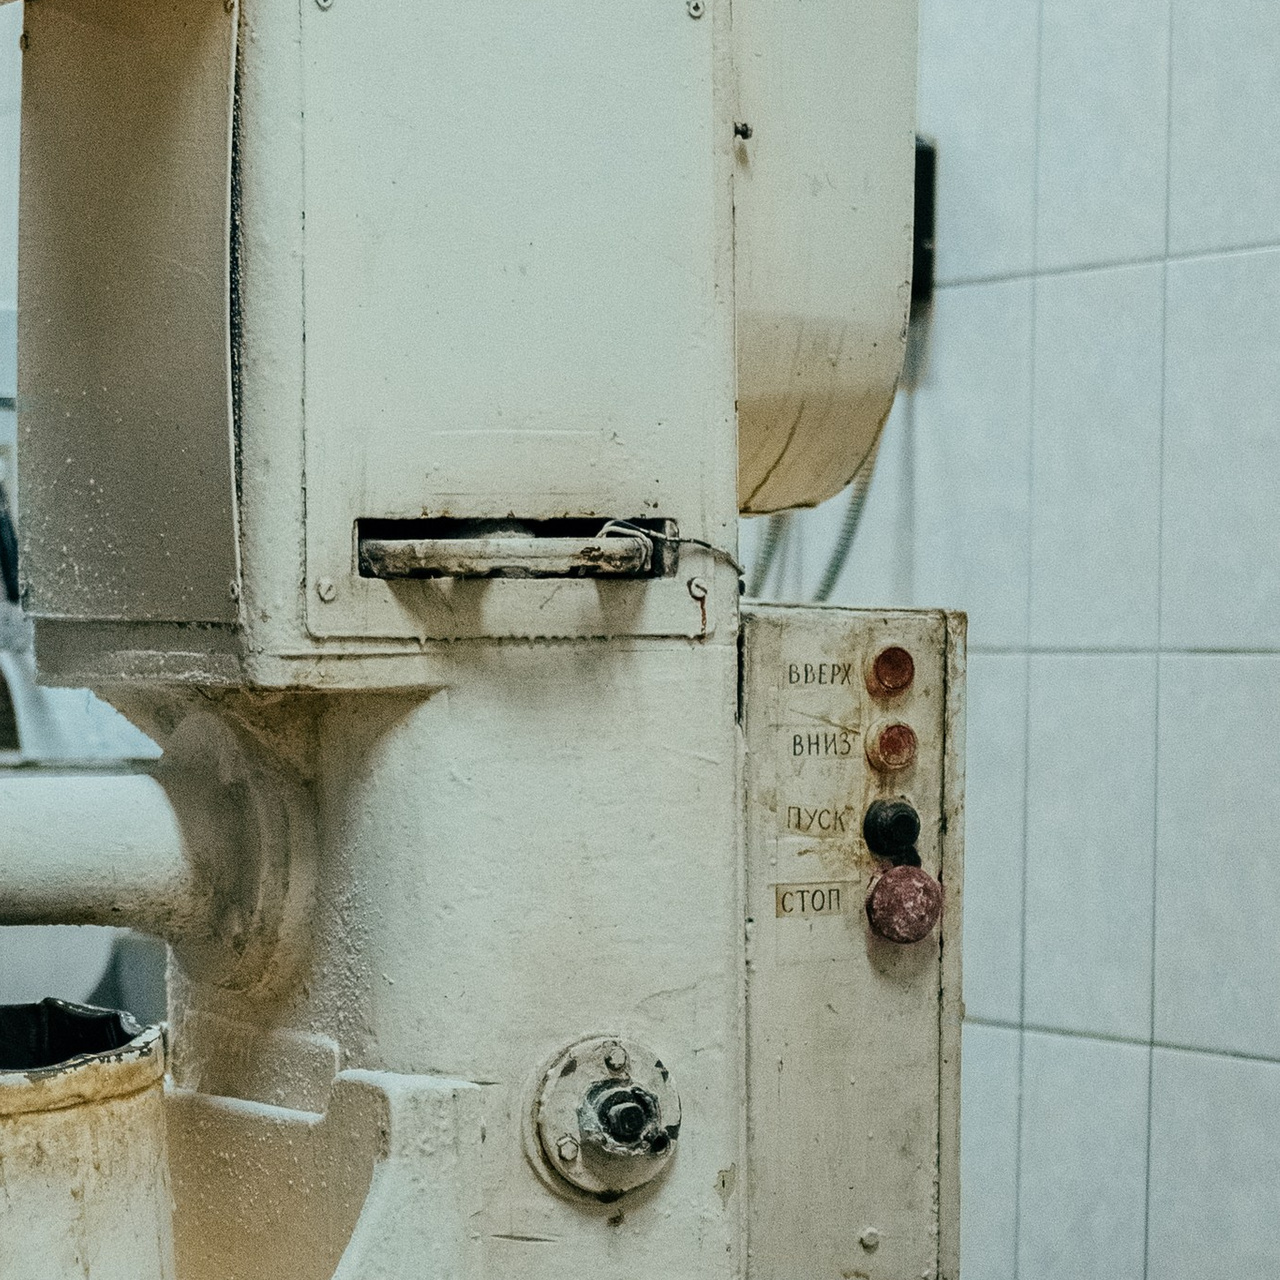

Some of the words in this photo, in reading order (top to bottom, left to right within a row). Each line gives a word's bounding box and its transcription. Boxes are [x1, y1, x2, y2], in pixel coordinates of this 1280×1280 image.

[788, 663, 852, 685] ВВЕРХ
[792, 733, 852, 756] ВНИЗ
[786, 806, 846, 832] ПУСК
[781, 889, 841, 913] СТОП
